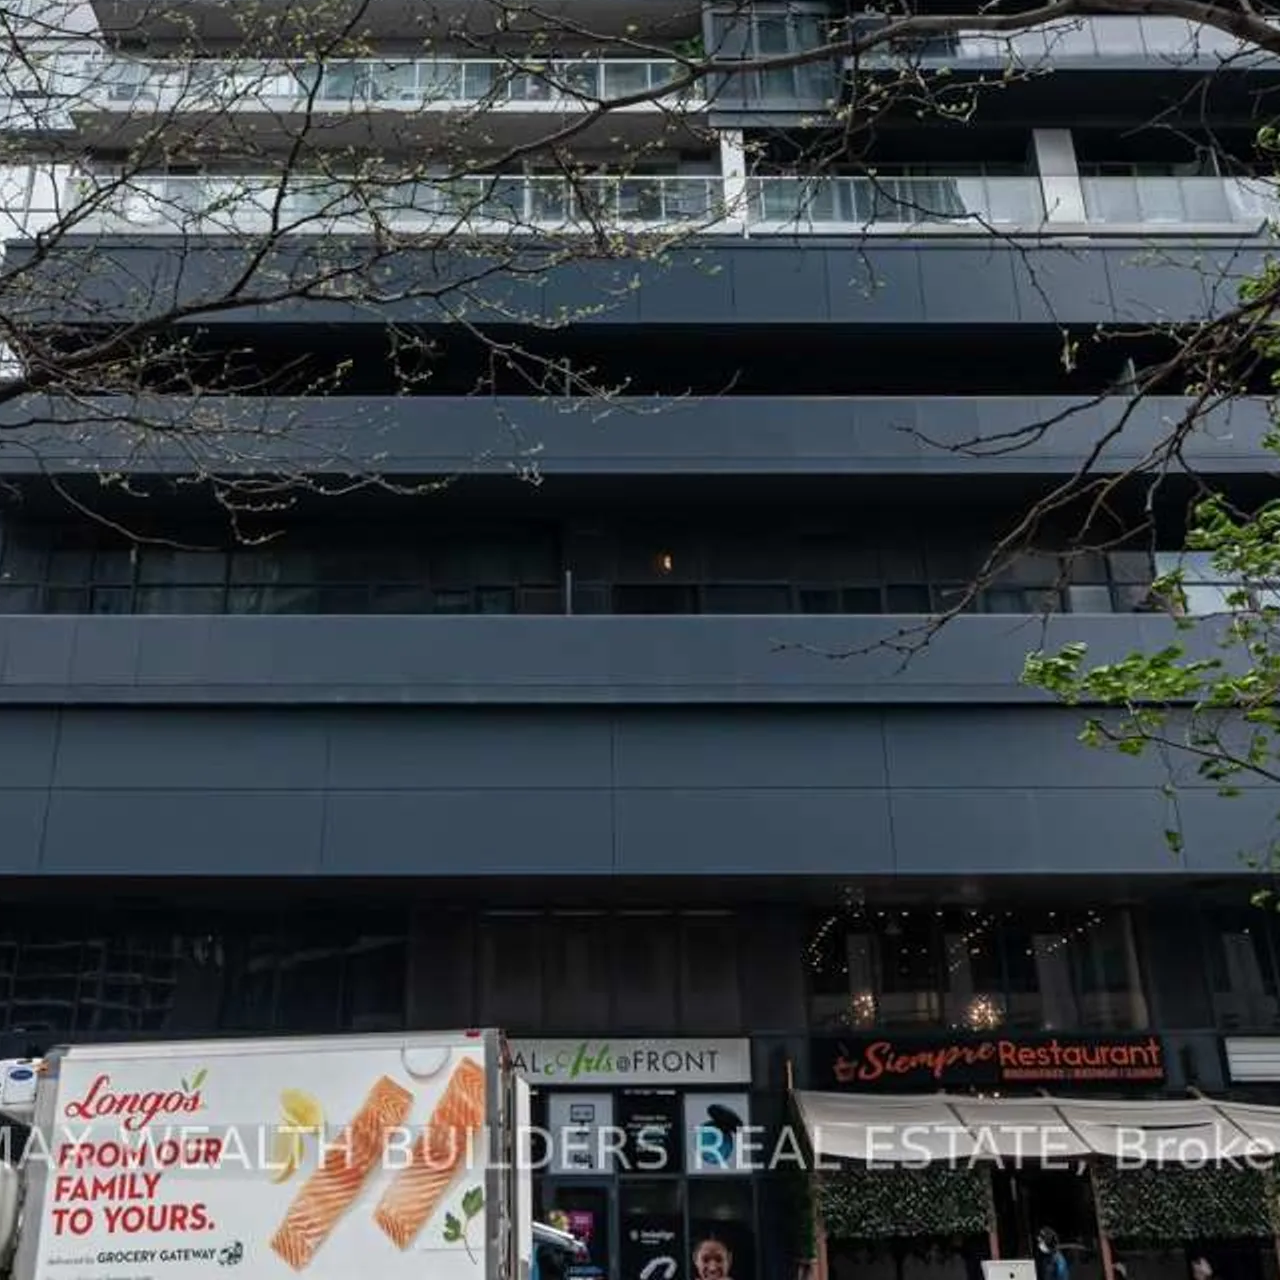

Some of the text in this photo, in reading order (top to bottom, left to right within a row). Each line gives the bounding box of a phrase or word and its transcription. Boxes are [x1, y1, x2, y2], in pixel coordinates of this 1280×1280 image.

[859, 1039, 1161, 1080] Siempre Restaurant
[58, 1138, 222, 1169] FROM OUR
[54, 1172, 162, 1202] FAMILY
[52, 1203, 215, 1235] TO YOURS.
[96, 1249, 157, 1264] GROCERY
[159, 1248, 217, 1262] GATEWAY
